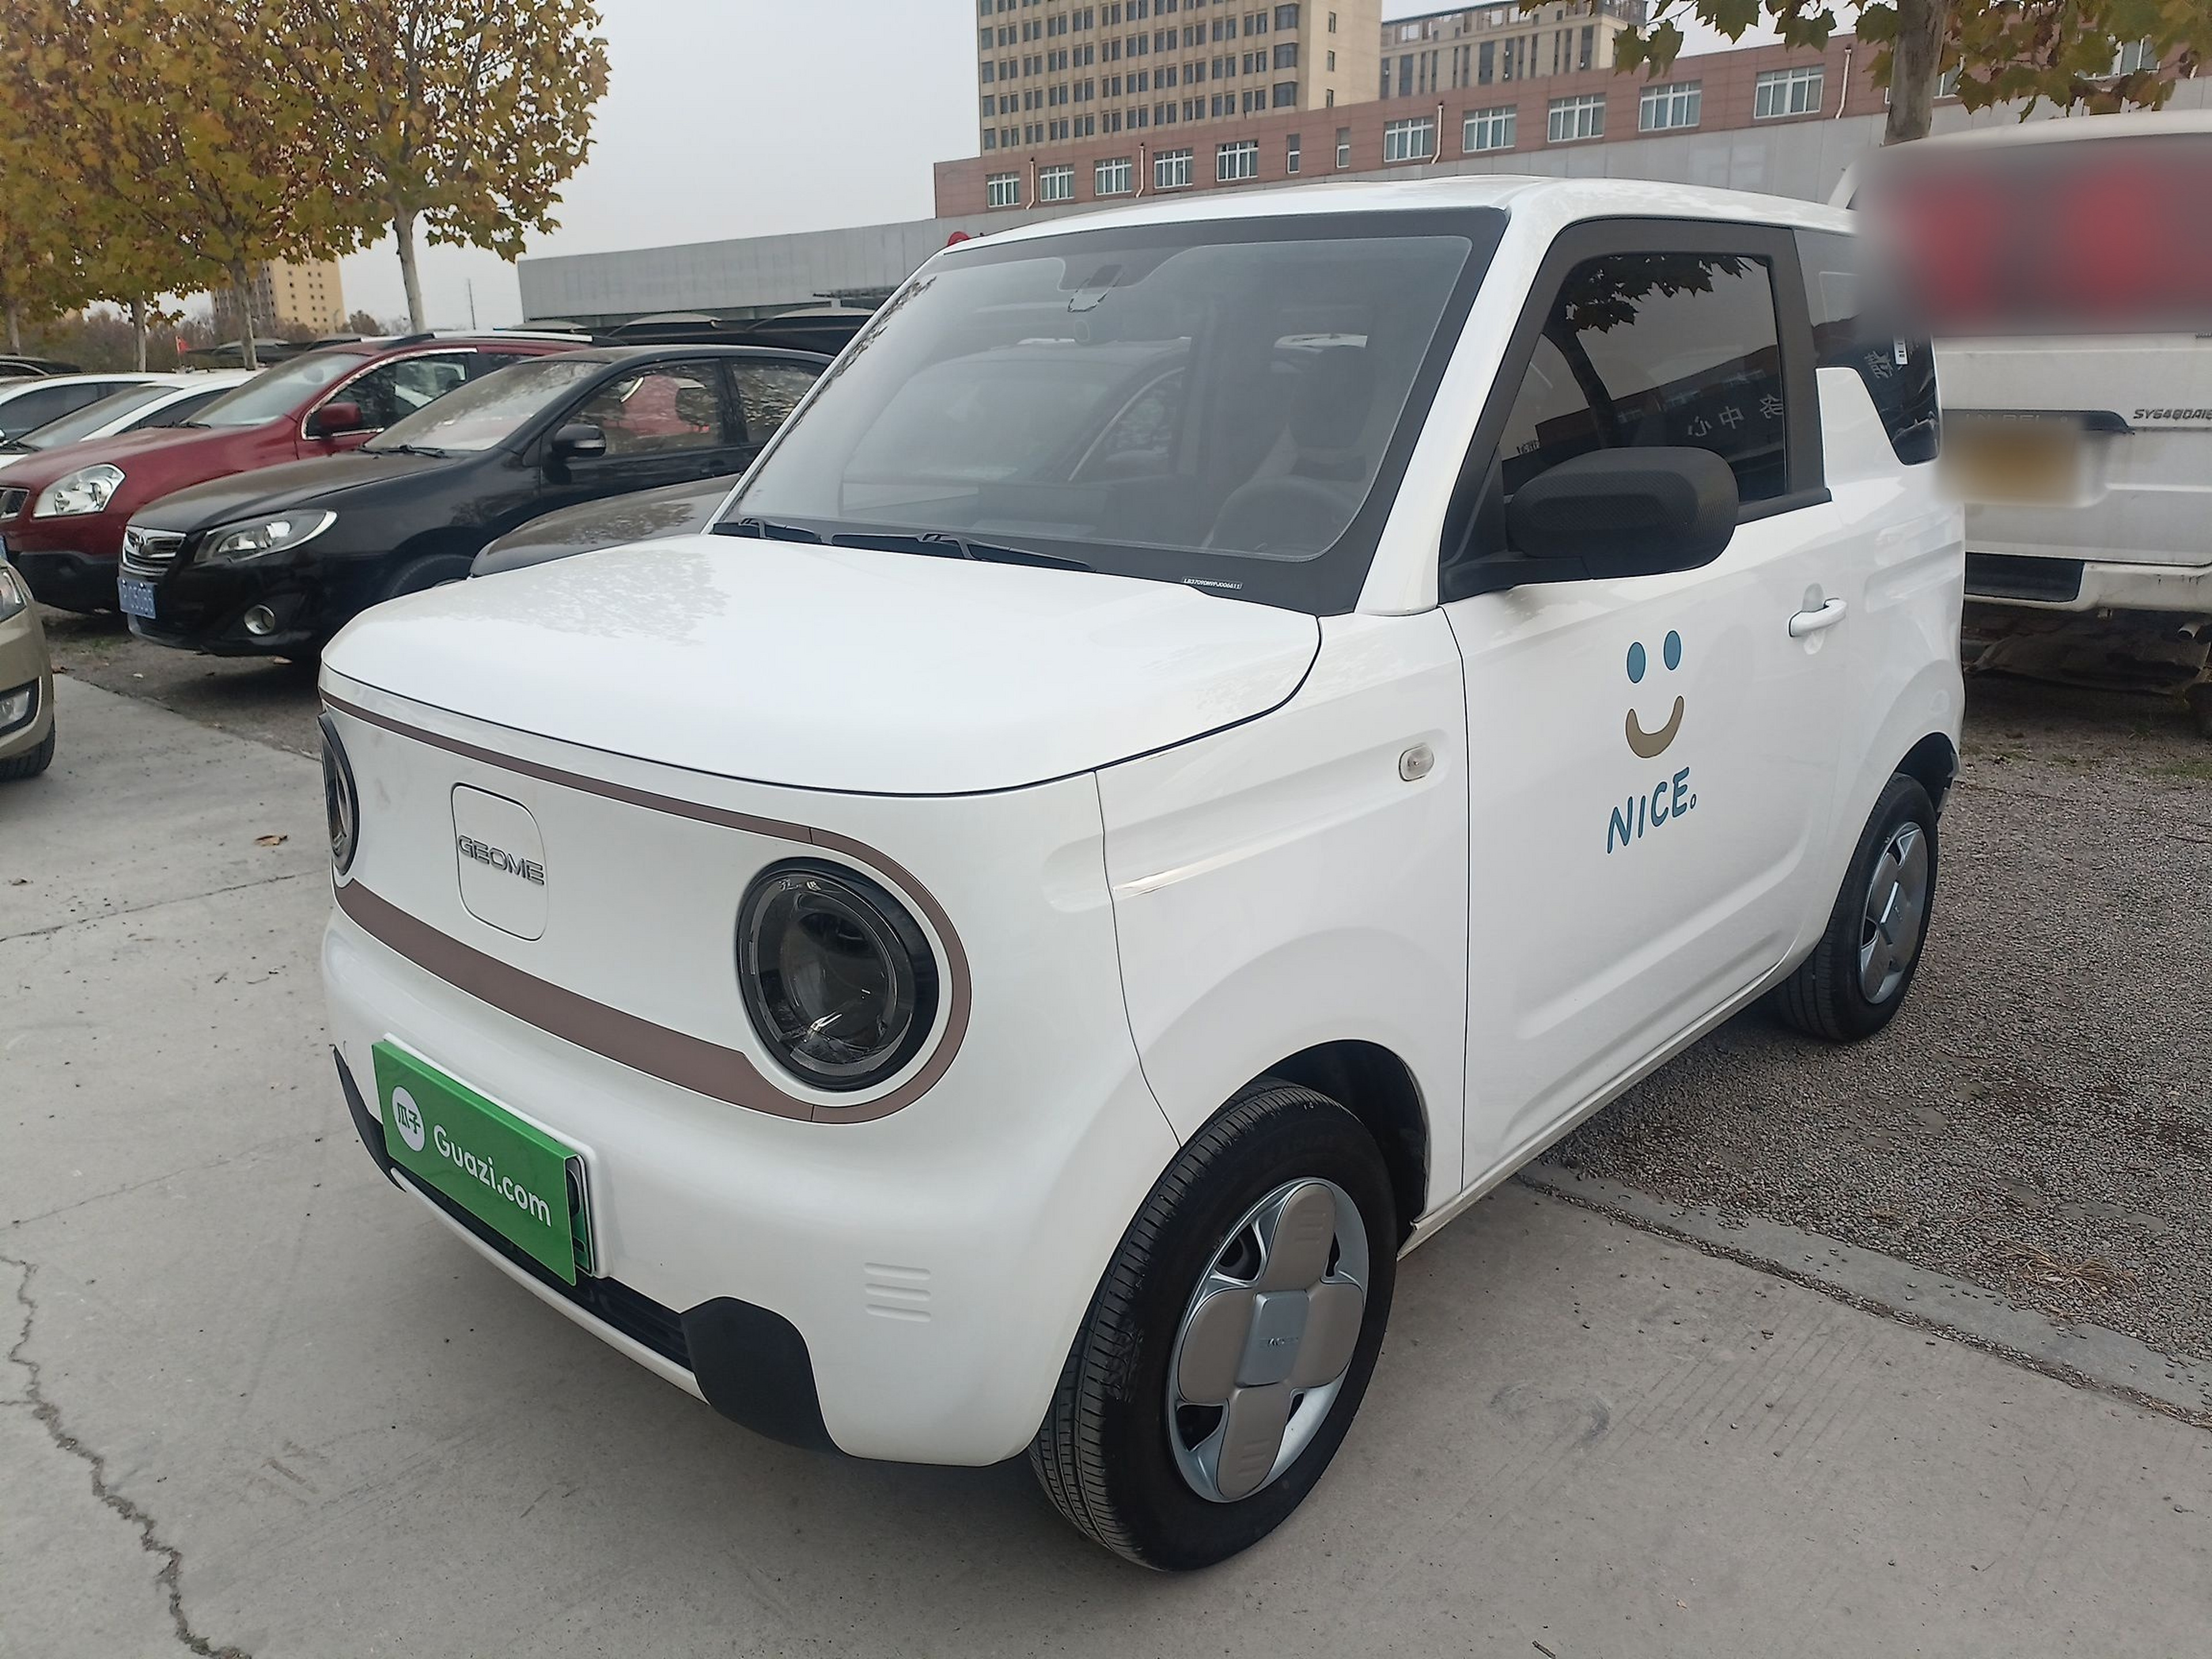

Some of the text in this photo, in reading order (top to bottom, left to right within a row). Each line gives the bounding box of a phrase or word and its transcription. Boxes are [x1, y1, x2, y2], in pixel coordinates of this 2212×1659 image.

[458, 835, 545, 885] GEOME
[397, 1101, 421, 1134] 瓜子
[433, 1124, 552, 1228] Guazi.com
